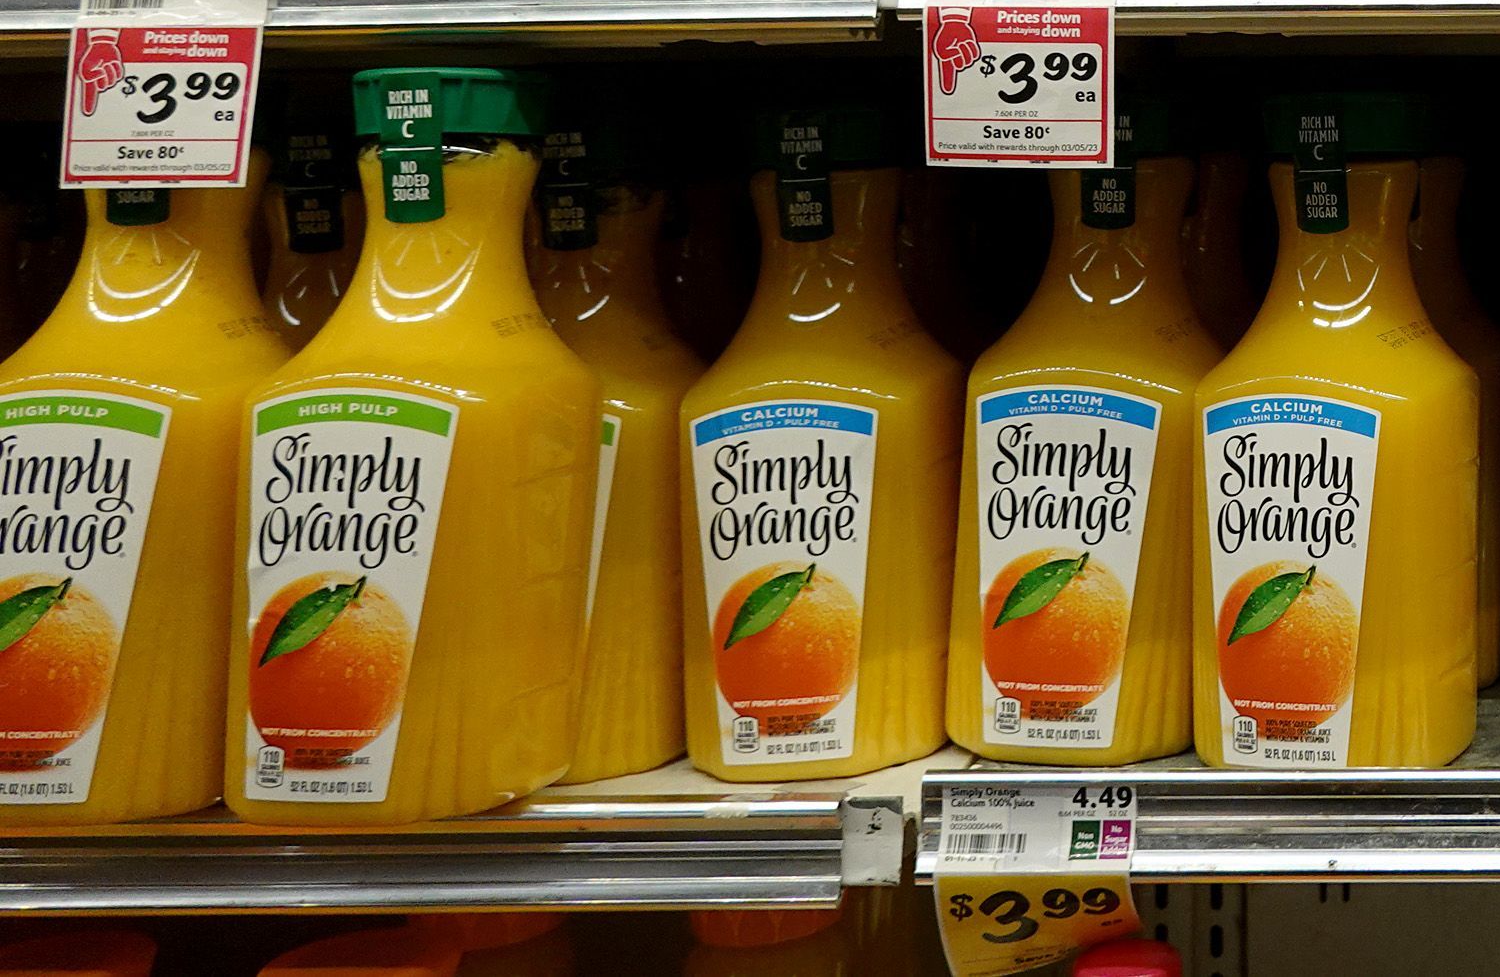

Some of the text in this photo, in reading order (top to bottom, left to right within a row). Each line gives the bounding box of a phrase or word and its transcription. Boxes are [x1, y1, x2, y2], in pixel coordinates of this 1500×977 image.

[997, 11, 1080, 24] Prices down
[1041, 25, 1080, 37] down
[389, 89, 428, 104] RICH IN
[1075, 90, 1095, 102] ea
[387, 105, 432, 119] VITAMIN
[402, 121, 414, 138] C
[984, 126, 1020, 139] Save
[118, 147, 153, 159] Save
[400, 162, 417, 173] NO
[392, 175, 429, 187] ADDED
[393, 189, 430, 201] SUGAR
[299, 403, 398, 417] HIGH PULP
[1250, 402, 1323, 414] CALCIUM
[266, 433, 424, 512] Simply
[1220, 433, 1359, 507] Simply
[1218, 498, 1355, 558] Orange
[259, 503, 417, 569] Orange
[1073, 787, 1132, 808] 4.49
